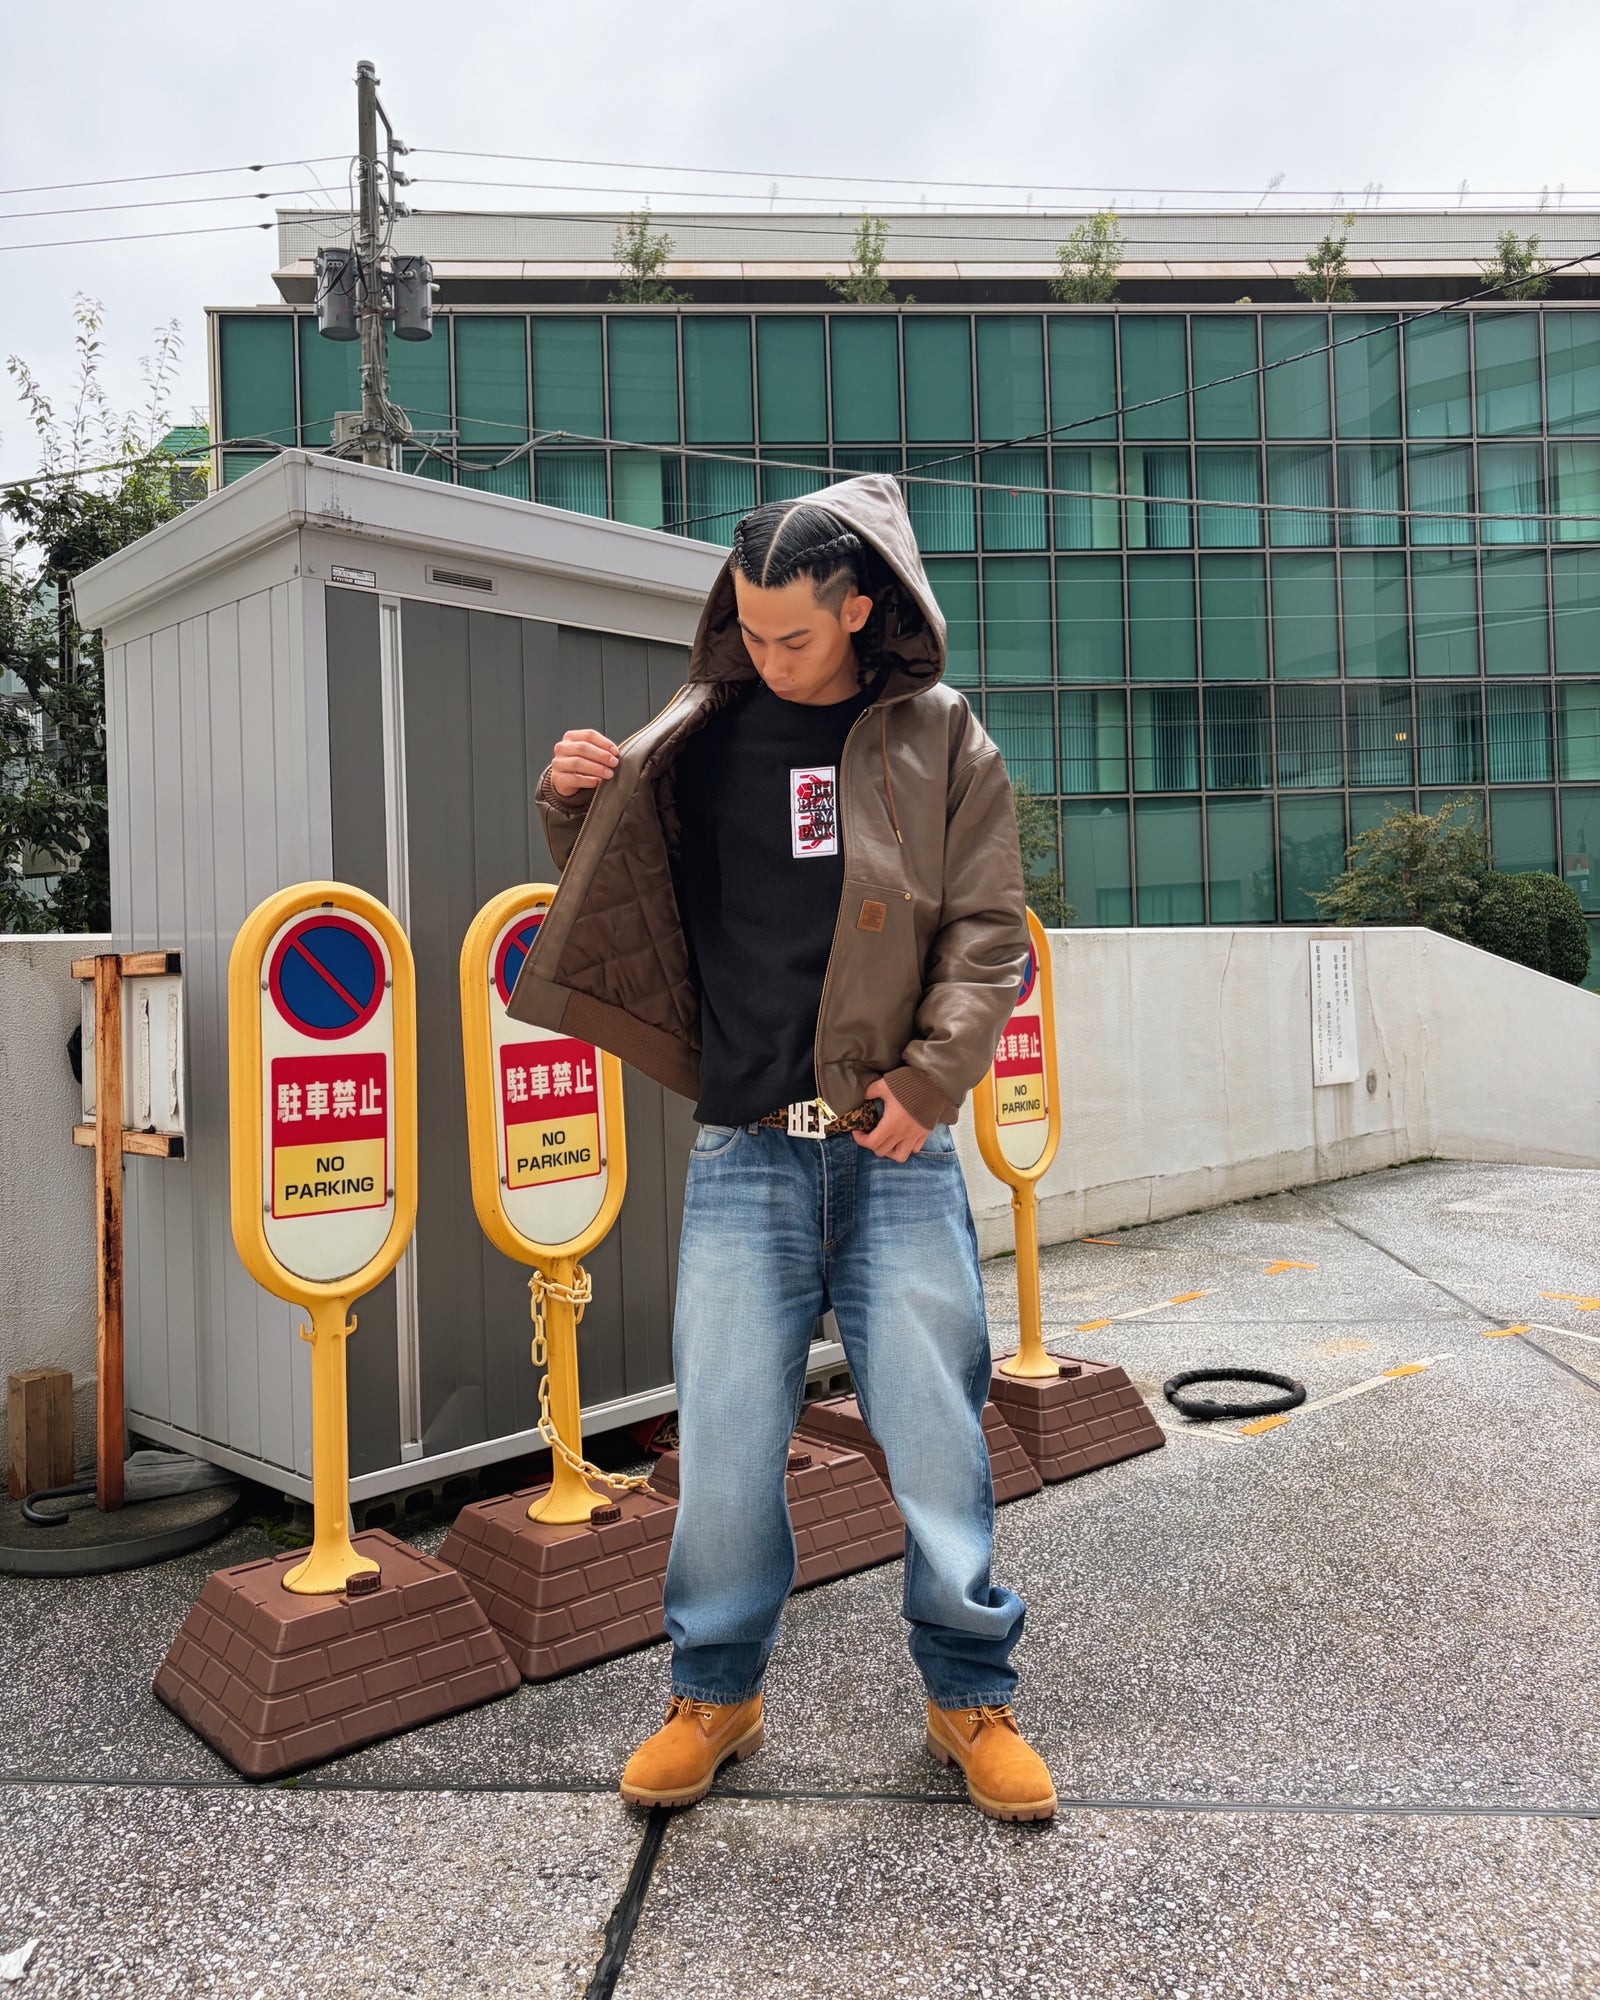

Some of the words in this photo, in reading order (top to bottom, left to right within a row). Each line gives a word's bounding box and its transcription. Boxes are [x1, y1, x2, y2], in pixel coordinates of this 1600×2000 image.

[506, 1058, 594, 1104] 駐車禁止
[1014, 1084, 1028, 1097] NO
[277, 1078, 383, 1124] 駐車禁止
[1001, 1099, 1041, 1114] PARKING
[541, 1130, 566, 1147] NO
[316, 1156, 345, 1174] NO
[517, 1148, 591, 1173] PARKING
[284, 1176, 375, 1201] PARKING
